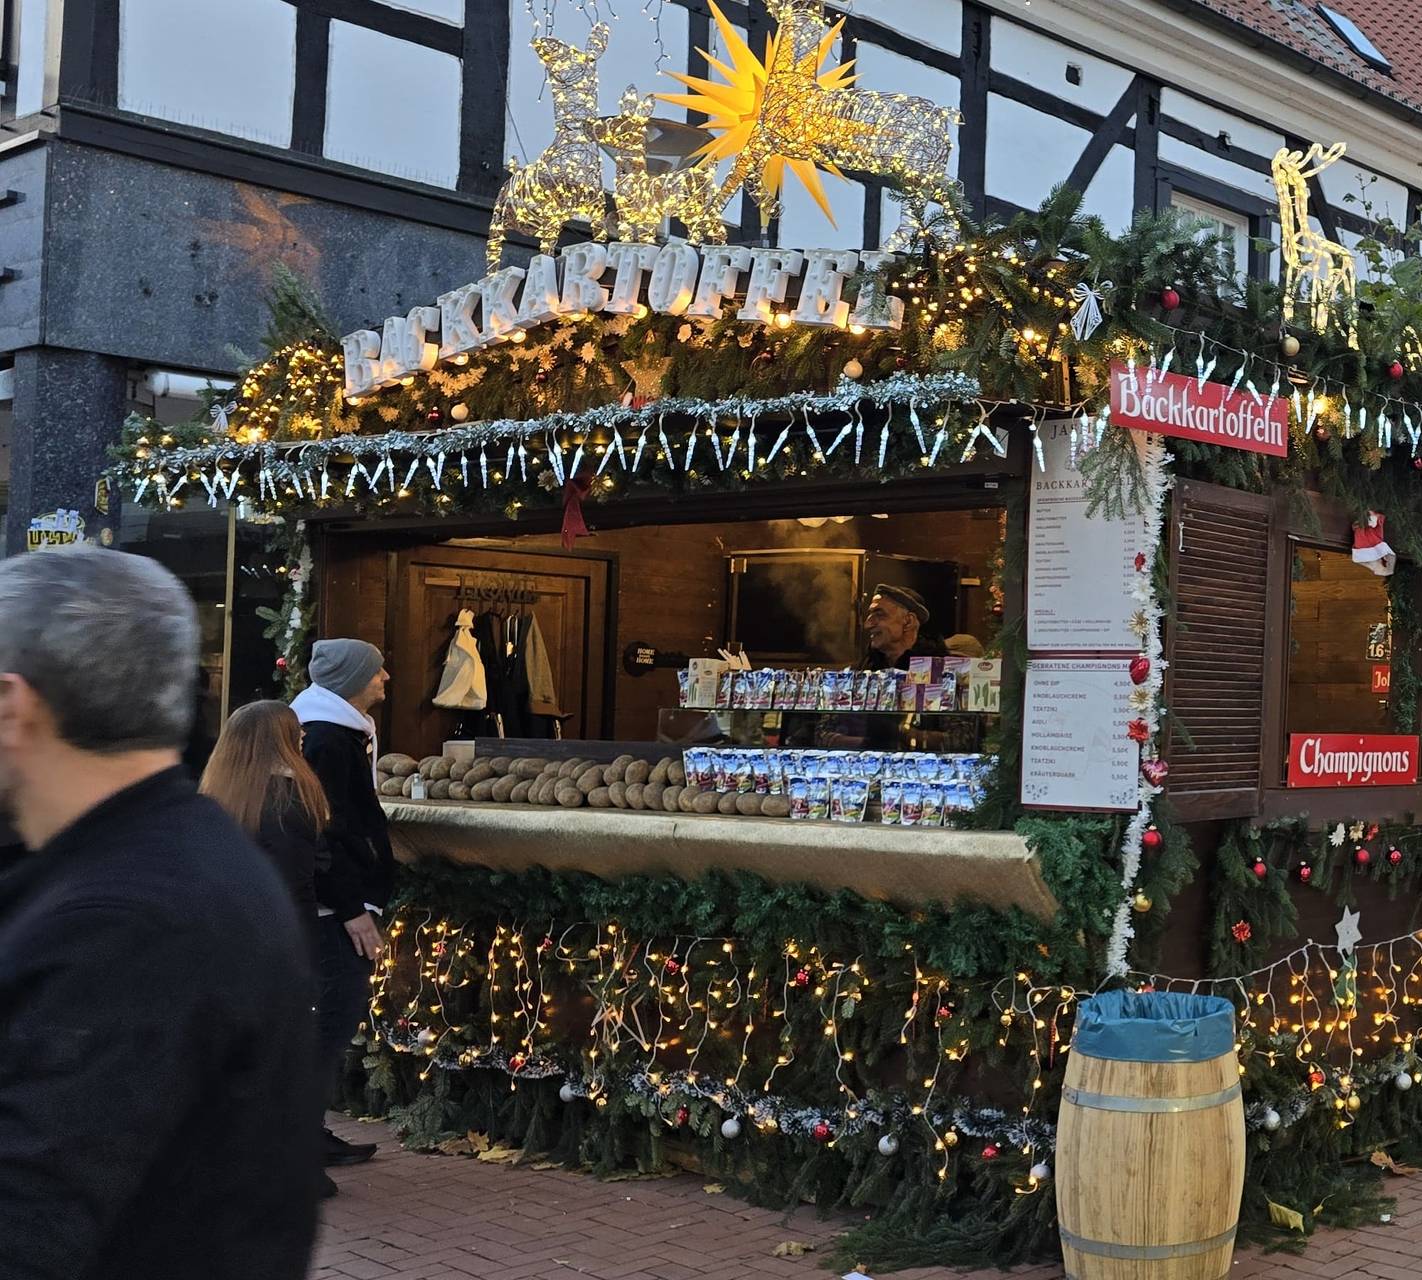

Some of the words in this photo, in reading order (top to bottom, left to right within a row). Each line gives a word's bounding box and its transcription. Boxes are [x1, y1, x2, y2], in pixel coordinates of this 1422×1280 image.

[1118, 372, 1284, 447] Backkartoffeln
[1032, 662, 1070, 670] GEBRATENE
[1071, 662, 1120, 670] CHAMPIGNONS
[1300, 737, 1410, 783] Champignons
